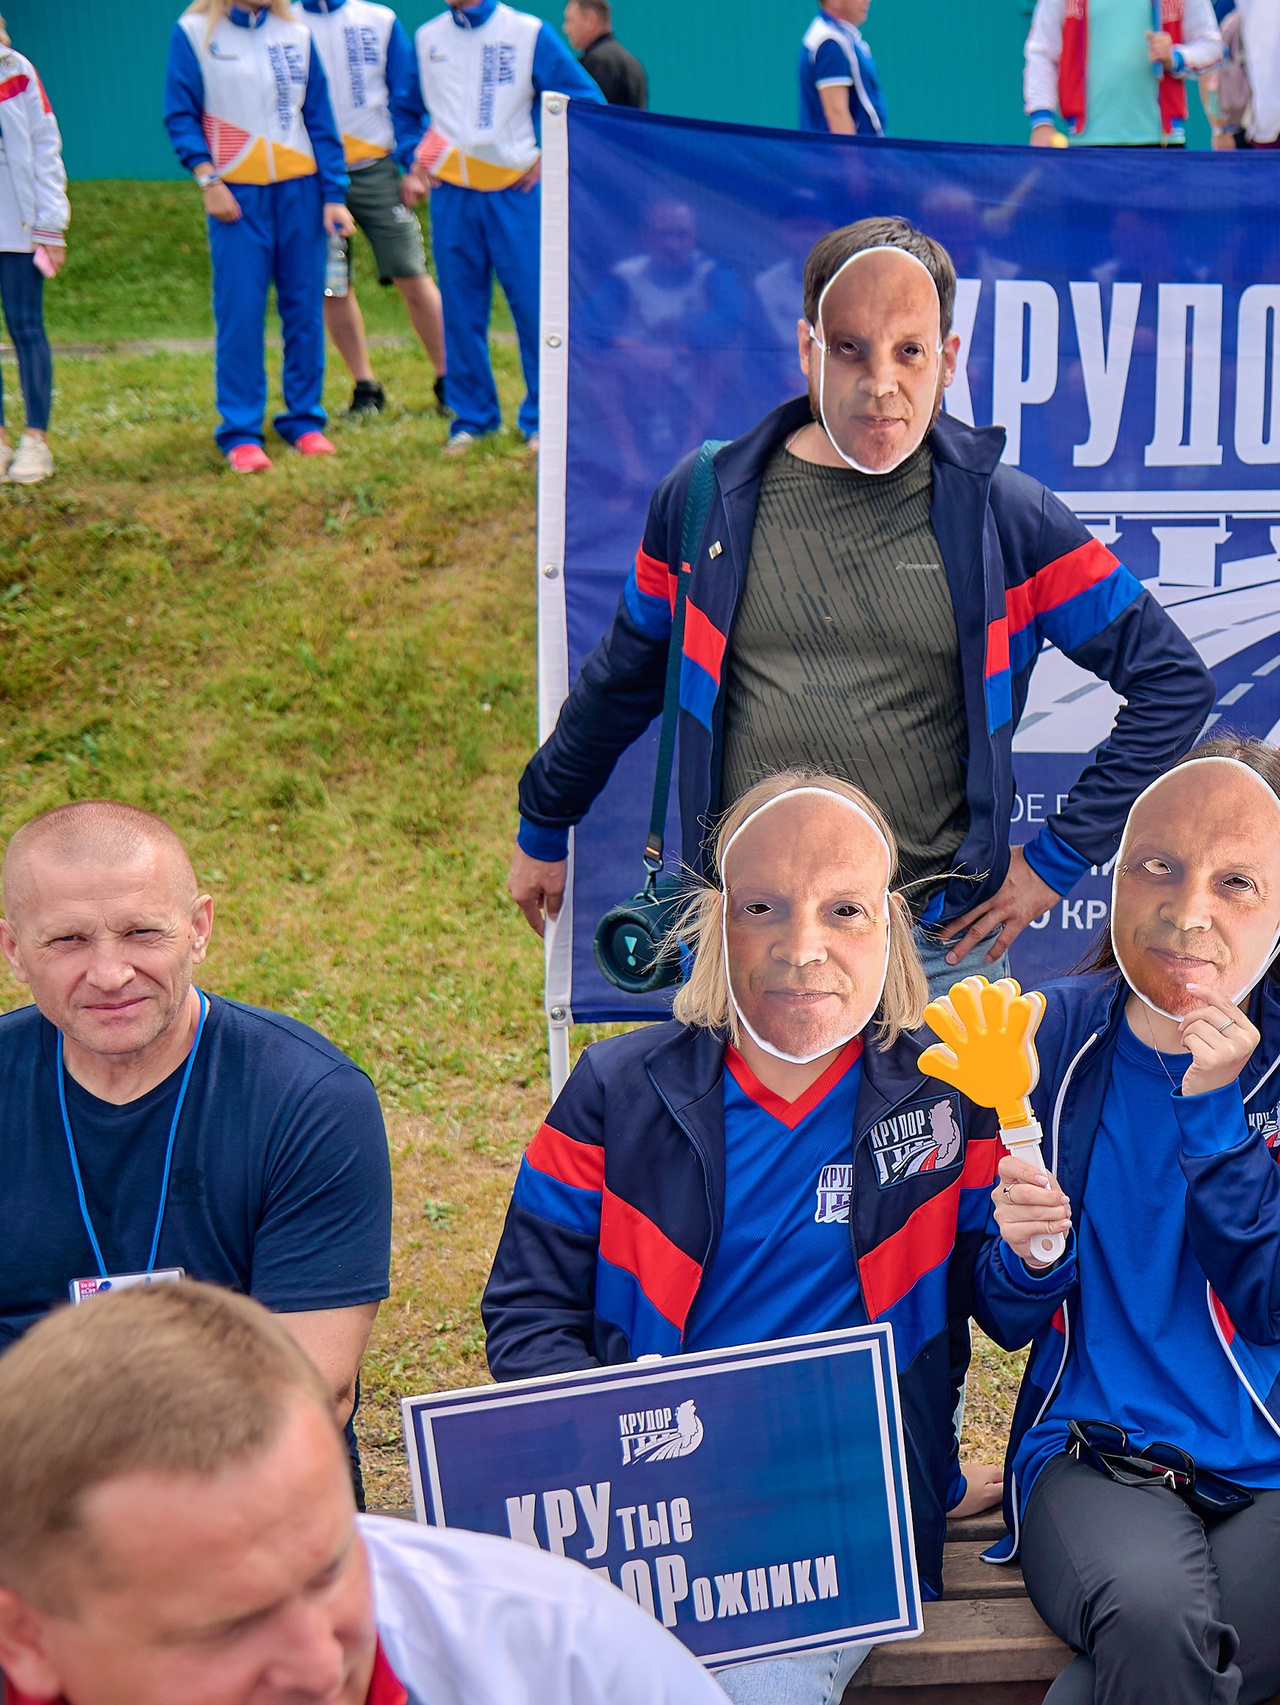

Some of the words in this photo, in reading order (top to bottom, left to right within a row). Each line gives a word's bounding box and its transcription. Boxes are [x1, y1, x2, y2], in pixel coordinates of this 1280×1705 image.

[870, 1109, 926, 1149] КРУДОР
[1248, 1112, 1270, 1131] КРУ
[821, 1166, 853, 1188] КРУД
[619, 1407, 673, 1435] КРУДОР
[506, 1481, 694, 1559] КРУтые
[590, 1554, 840, 1628] ОРожники
